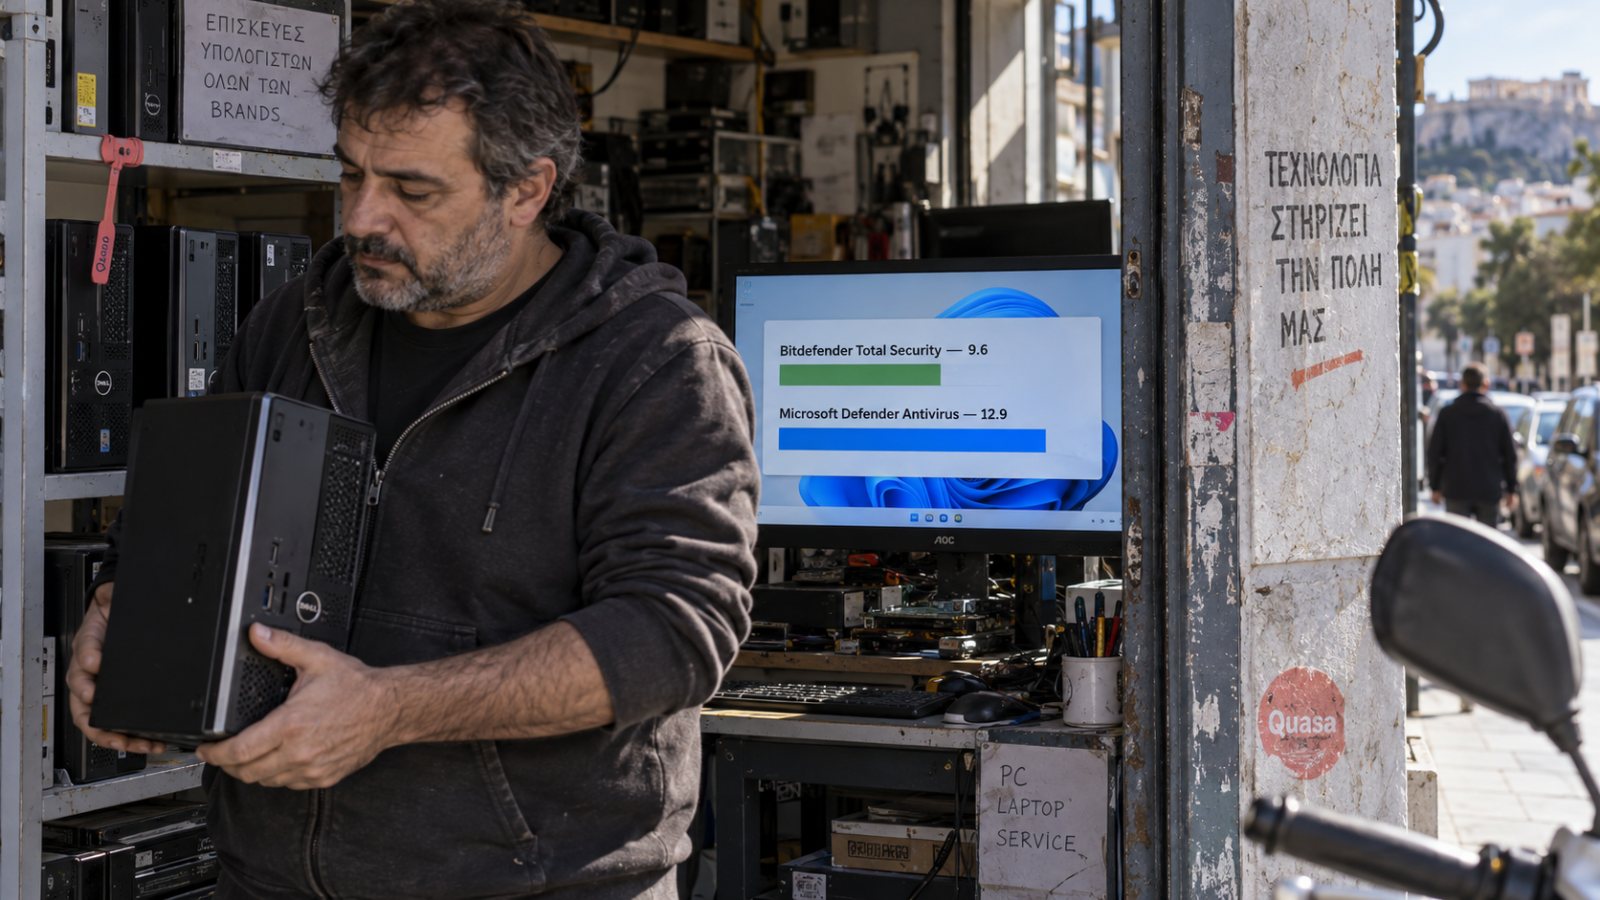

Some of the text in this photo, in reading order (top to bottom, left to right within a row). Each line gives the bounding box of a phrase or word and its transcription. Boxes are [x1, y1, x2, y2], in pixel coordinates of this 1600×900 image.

[206, 13, 305, 43] ΕΠΙΣΚΕΥΕΣ
[201, 41, 312, 71] ΥΠΟΛΟΓΙΣΤΩΝ
[204, 72, 290, 96] ΟΛΩΝ ΤΩΝ
[1264, 150, 1382, 188] ΤΕΧΝΟΛΟΓΙΑ
[1271, 203, 1368, 241] ΣΤΗΡΙΖΕΙ
[1275, 252, 1382, 294] ΤΗΝ ΠΟΛΗ
[1280, 307, 1326, 349] ΜΑΣ
[780, 344, 853, 357] Bitdefender
[855, 344, 887, 356] Total
[889, 344, 942, 359] Security
[968, 344, 989, 356] 9.6
[779, 408, 838, 420] Microsoft
[841, 408, 900, 420] Defender
[902, 408, 960, 420] Antivirus
[981, 408, 1008, 421] 12.9
[934, 535, 955, 545] AOC
[1268, 709, 1337, 738] Quasa
[1000, 764, 1028, 787] PC
[997, 796, 1065, 818] LAPTOP
[996, 828, 1076, 853] SERVICE
